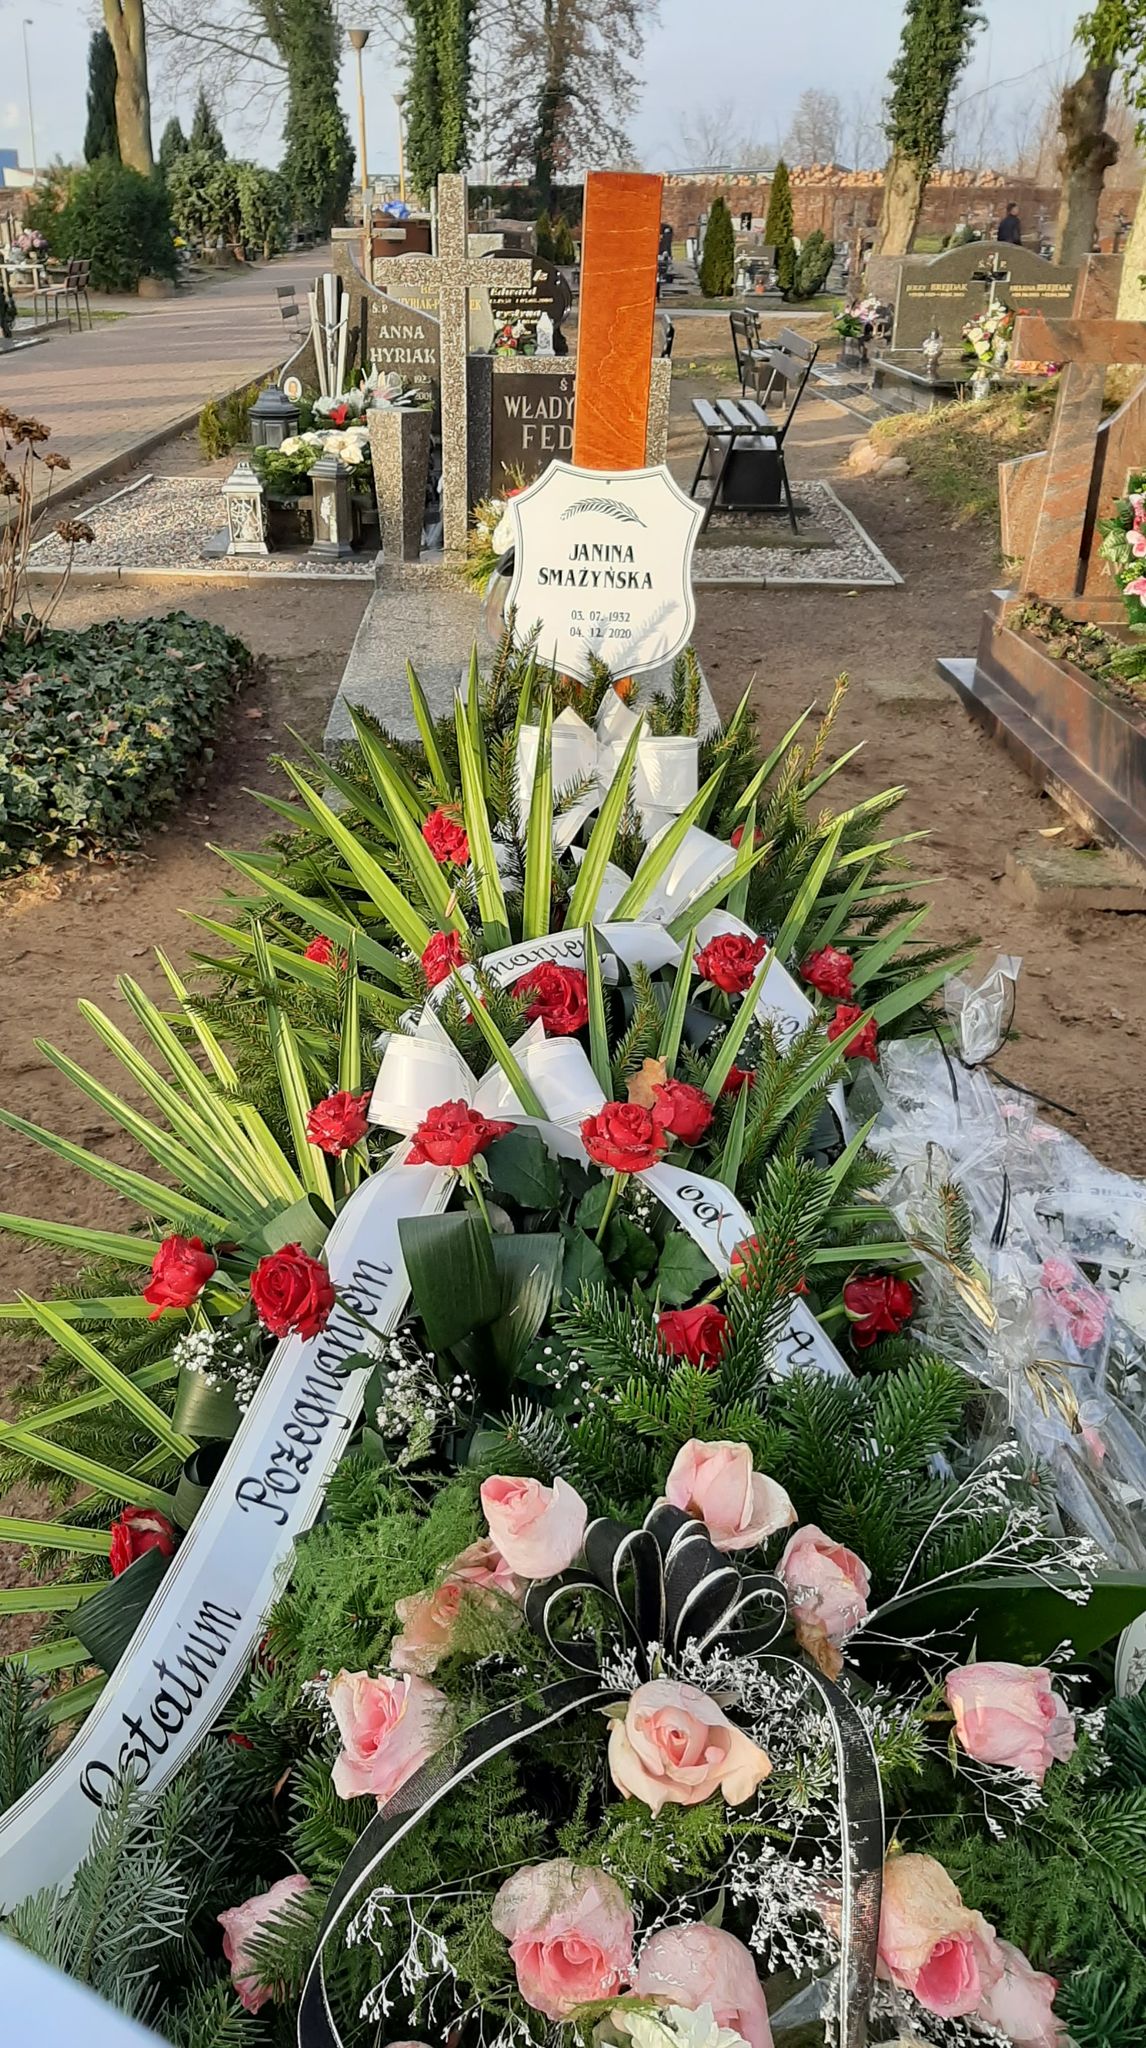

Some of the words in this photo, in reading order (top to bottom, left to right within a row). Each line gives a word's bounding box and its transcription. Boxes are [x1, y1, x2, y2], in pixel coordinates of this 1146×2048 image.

[378, 325, 425, 340] ANNA
[369, 346, 436, 364] HYRIAK
[503, 395, 575, 420] WŁADY
[522, 423, 574, 452] FĘD
[568, 543, 635, 563] JANINA
[537, 566, 654, 590] SMAŻYŃSKA
[571, 610, 585, 621] 03.
[589, 611, 604, 622] 07.
[608, 612, 631, 623] 1932
[569, 627, 584, 638] 04.
[590, 628, 604, 639] 12.
[609, 628, 632, 640] 2020
[79, 1600, 243, 1811] Ostatnim
